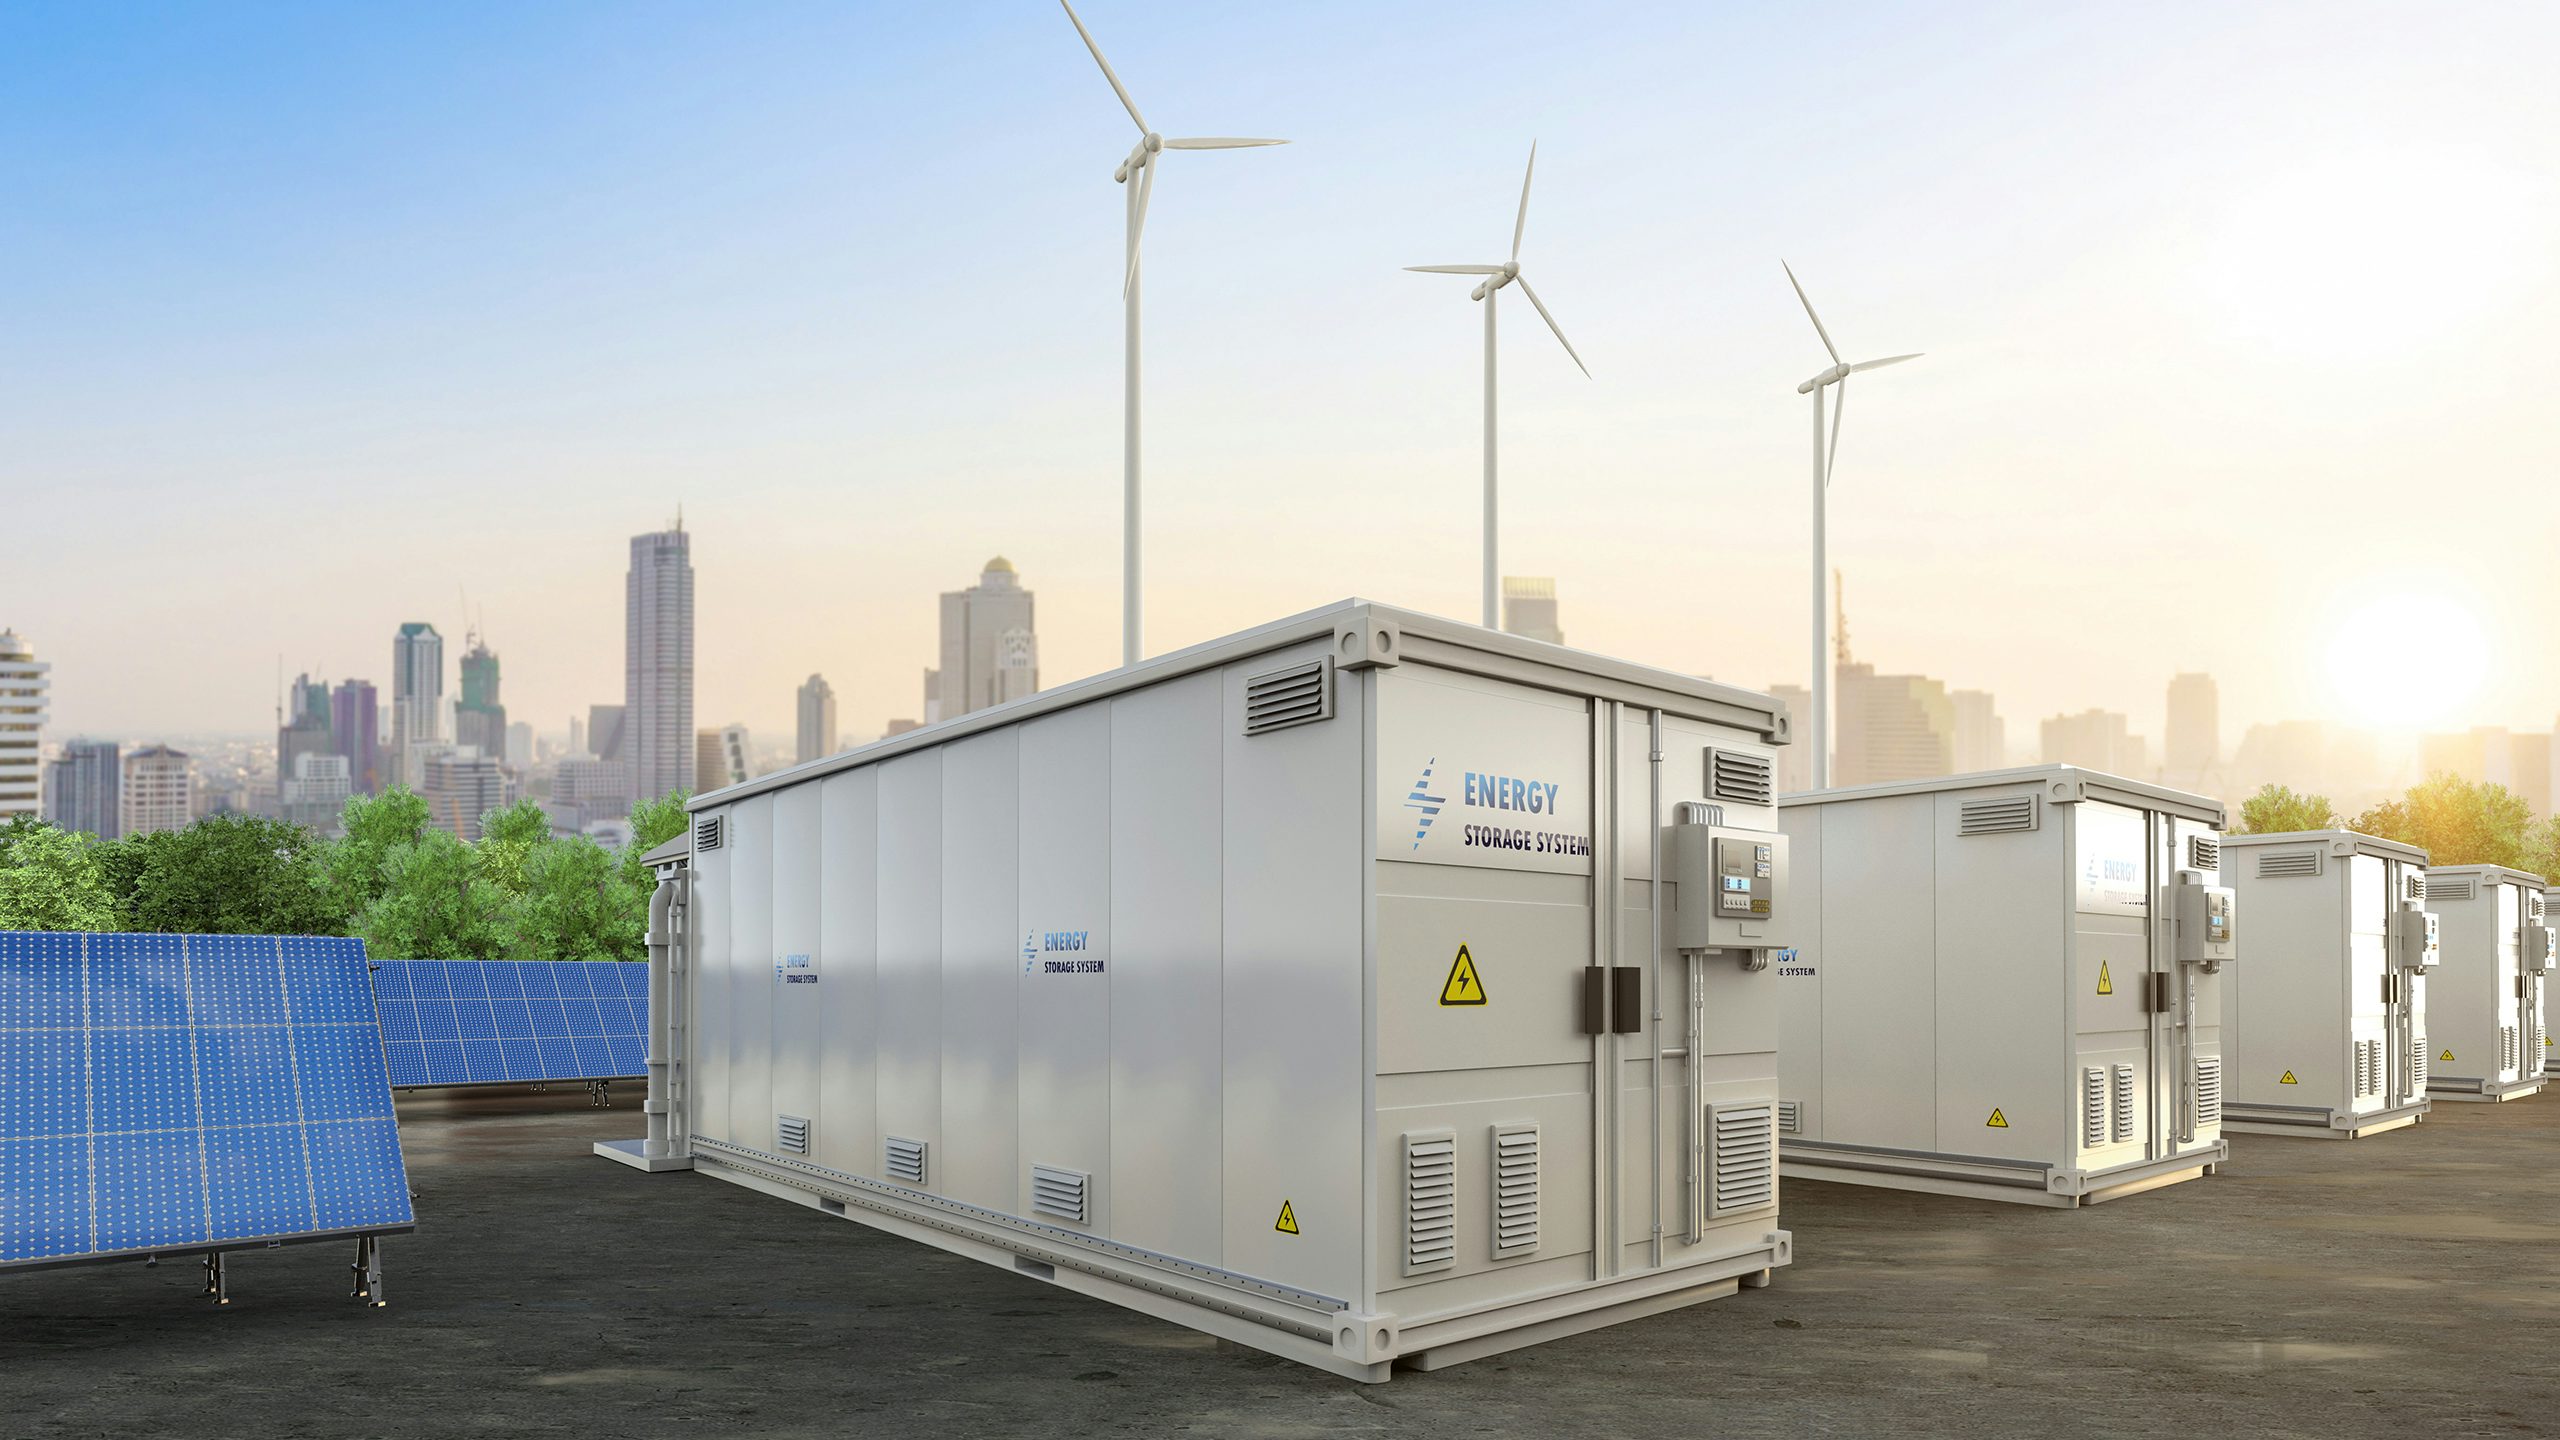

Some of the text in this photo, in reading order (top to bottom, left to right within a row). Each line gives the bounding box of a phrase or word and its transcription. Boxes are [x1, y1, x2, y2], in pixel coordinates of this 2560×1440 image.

[1464, 771, 1559, 815] ENERGY
[1464, 824, 1590, 856] STORAGE SYSTEM
[2104, 860, 2136, 882] ENERGY
[1045, 931, 1088, 951] ENERGY
[1044, 960, 1105, 973] STORAGE SYSTEM
[1785, 967, 1816, 976] SYSTEM
